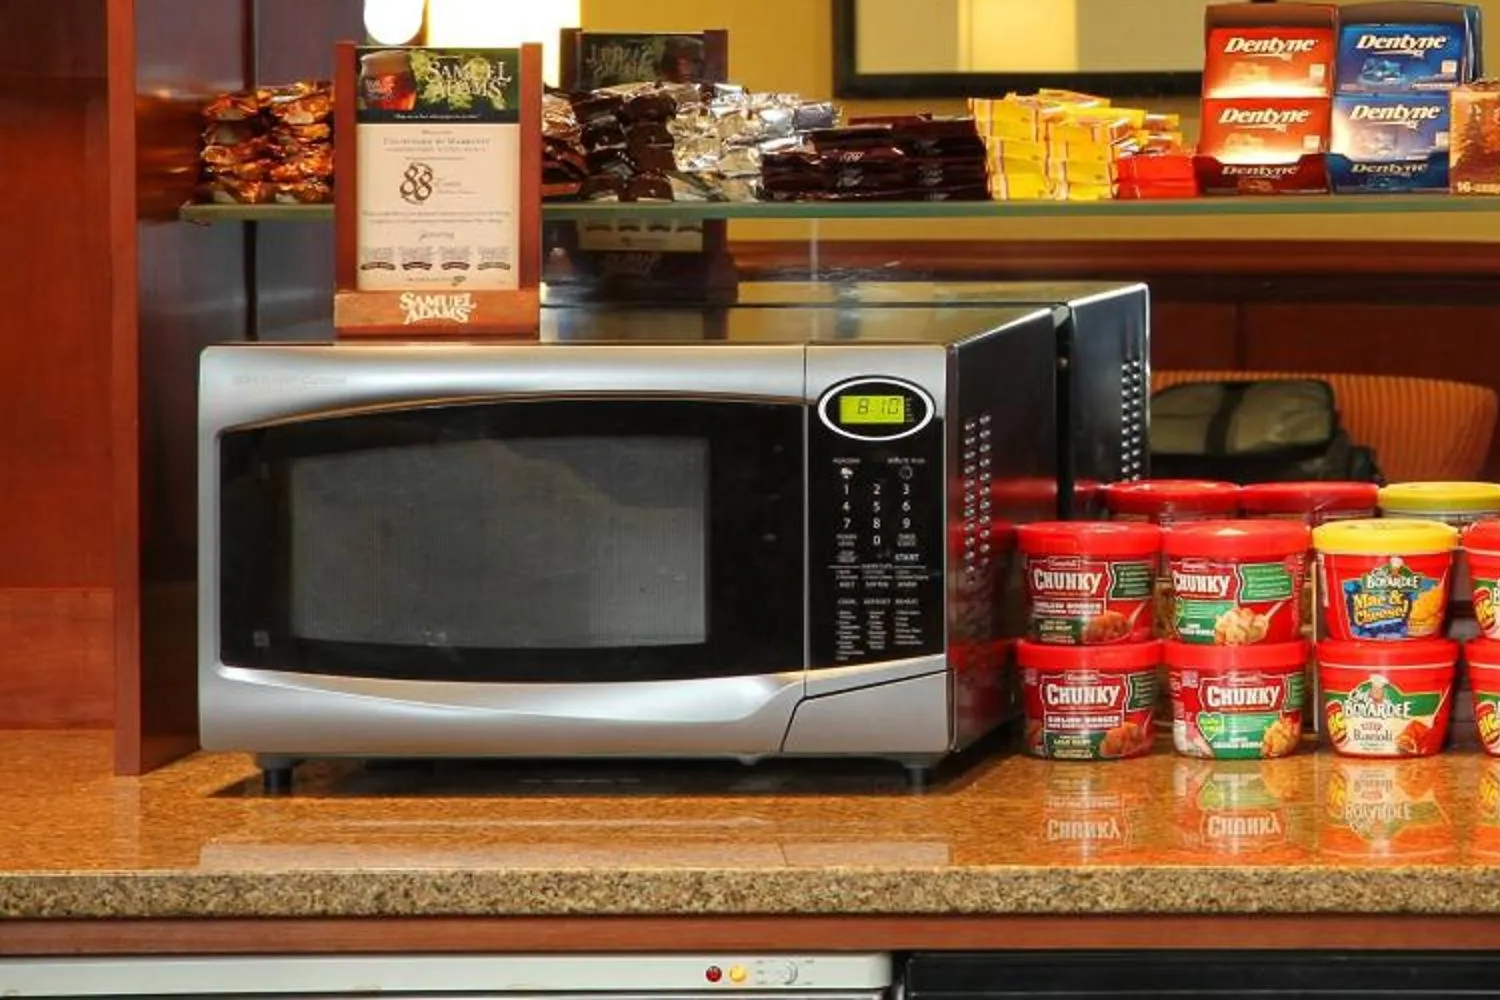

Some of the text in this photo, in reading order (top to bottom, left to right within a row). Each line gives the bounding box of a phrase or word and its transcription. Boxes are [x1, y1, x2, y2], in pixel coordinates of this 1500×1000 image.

[1223, 36, 1316, 56] Dentyne
[1356, 33, 1448, 54] Dentyne
[426, 57, 513, 83] SAMUEL
[1218, 105, 1311, 127] Dentyne
[1350, 103, 1443, 125] Dentyne
[1220, 164, 1300, 180] Dentyne
[1351, 162, 1429, 178] Dentyne
[399, 291, 477, 311] SAMUEL
[403, 303, 472, 325] ADAMS
[872, 484, 881, 496] 2
[872, 518, 881, 530] 8
[902, 518, 911, 530] 9
[872, 535, 881, 546] 0
[1033, 568, 1104, 595] CHUNKY
[1046, 683, 1122, 707] CHUNKY
[1206, 685, 1282, 708] CHUNKY
[1344, 700, 1413, 720] BOYARDEE
